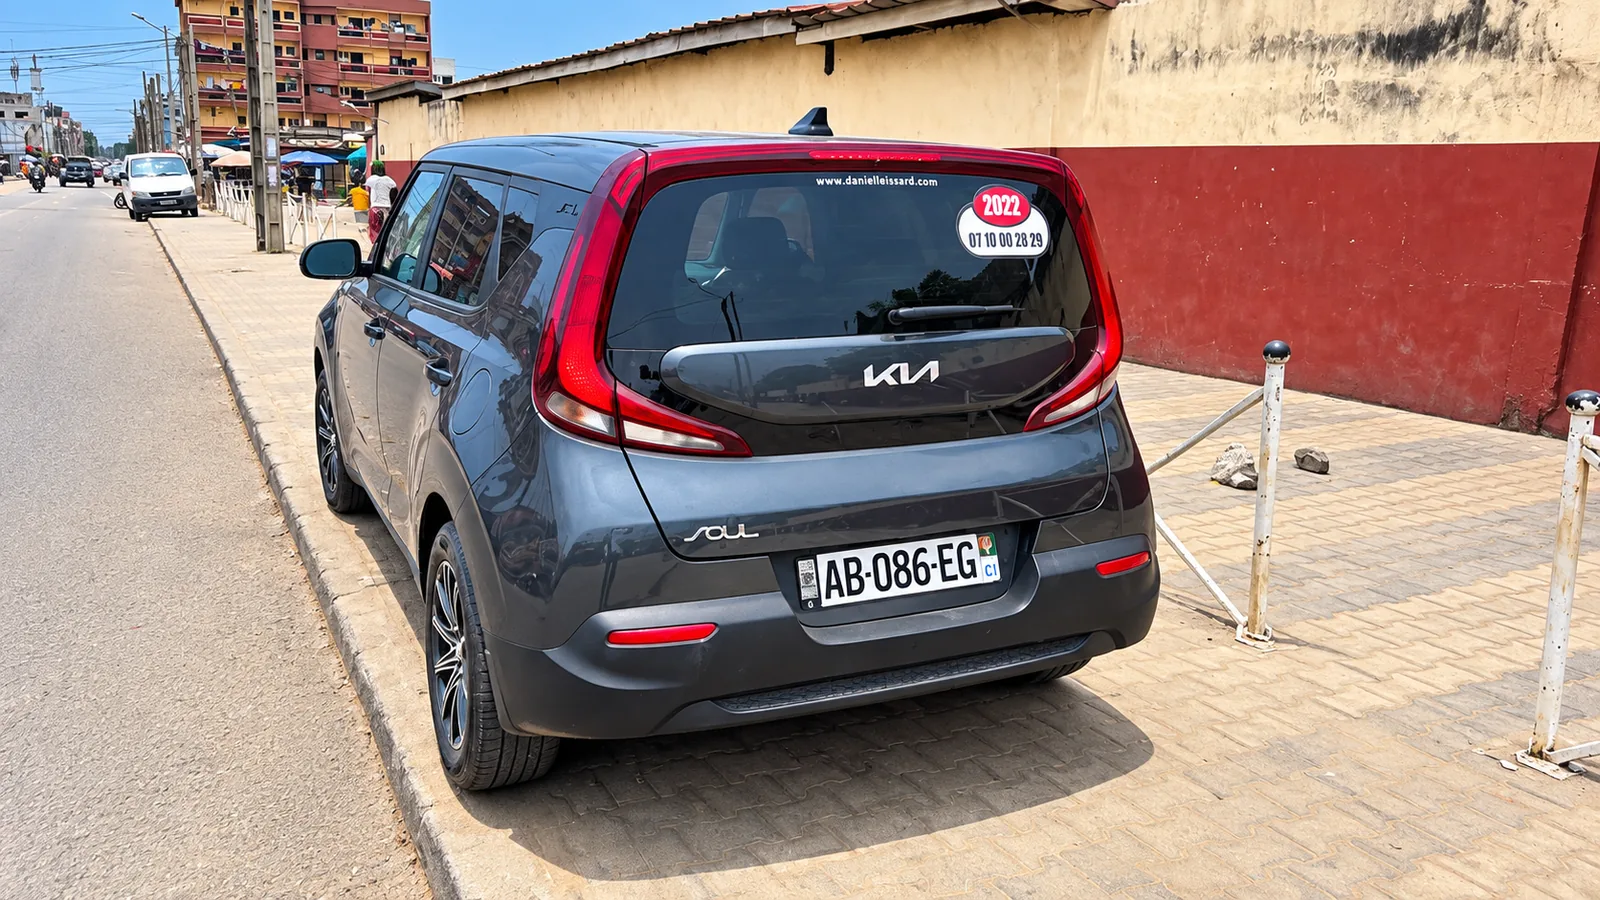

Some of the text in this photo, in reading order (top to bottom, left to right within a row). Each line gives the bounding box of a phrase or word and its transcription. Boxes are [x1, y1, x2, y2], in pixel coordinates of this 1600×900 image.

[816, 175, 938, 187] www.danielleissard.com
[982, 194, 1021, 216] 2022
[968, 232, 1043, 248] 07 10 00 28 29
[863, 360, 940, 387] KIA
[683, 523, 759, 542] SOUL
[825, 541, 977, 599] AB-086-EG
[984, 563, 998, 577] CI
